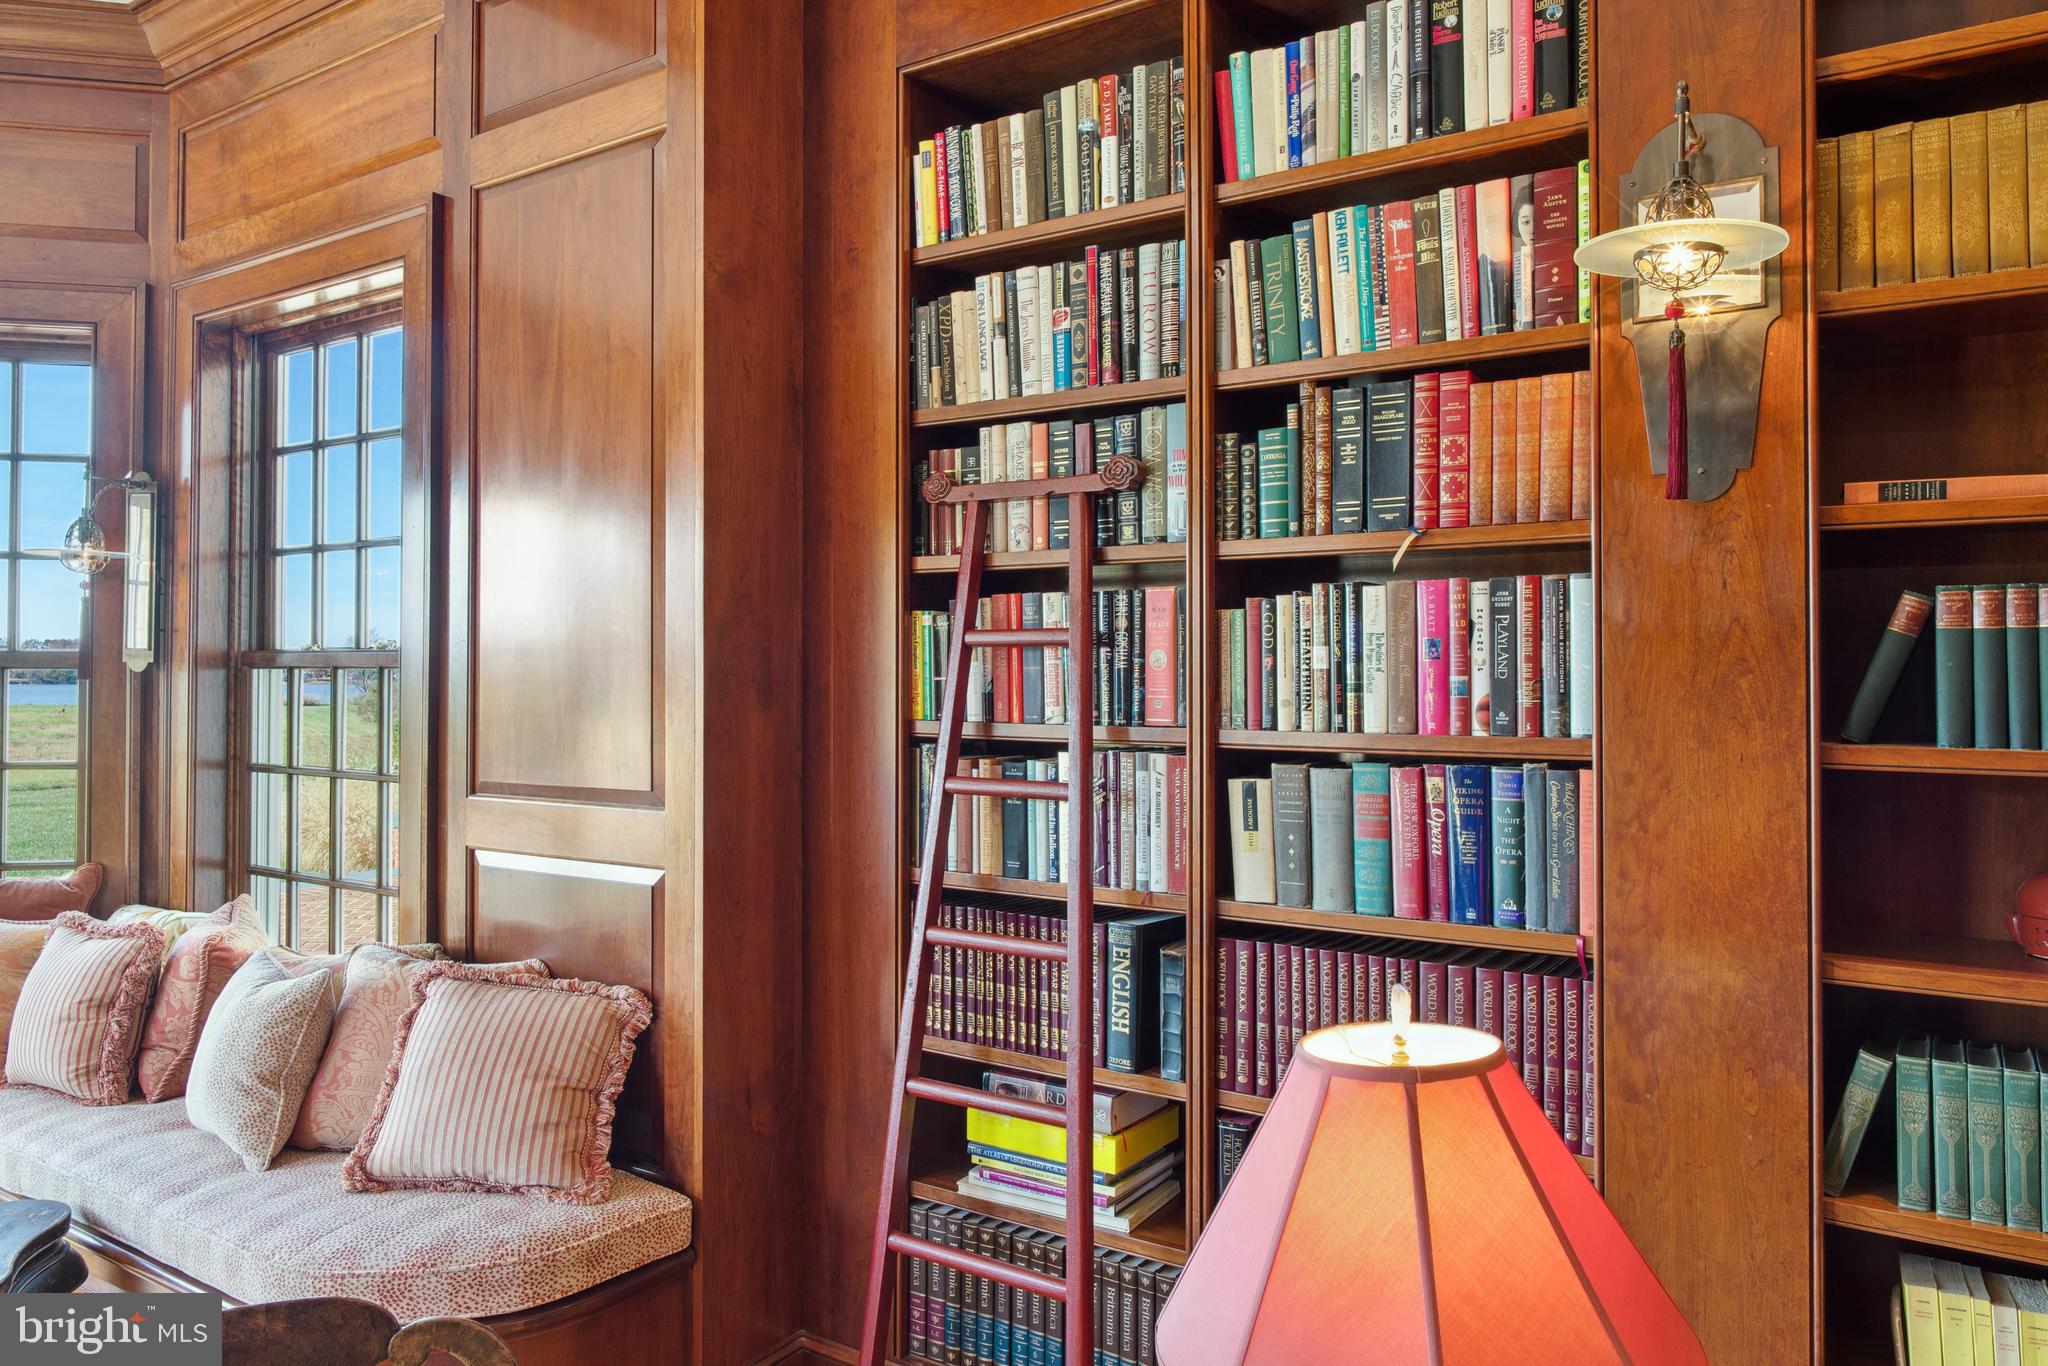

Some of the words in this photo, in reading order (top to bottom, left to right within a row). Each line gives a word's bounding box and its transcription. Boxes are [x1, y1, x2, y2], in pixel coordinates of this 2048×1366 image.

[1290, 59, 1299, 75] Our
[1518, 36, 1528, 99] ATONEMENT
[1103, 80, 1112, 89] P.
[1103, 91, 1112, 101] D.
[1149, 75, 1157, 95] GAY
[1157, 73, 1166, 93] THY
[1287, 75, 1299, 94] Gang
[1103, 103, 1112, 134] JAMES
[1149, 97, 1157, 134] TALESE
[1289, 95, 1300, 119] Philip
[1157, 95, 1166, 155] NEIGHBOR'S
[1288, 120, 1300, 137] Roth
[946, 129, 960, 174] MINDBEND
[1050, 124, 1058, 158] STRONG
[1081, 135, 1090, 165] COLD
[1051, 160, 1059, 201] MEDICINE
[1157, 157, 1166, 180] WIFE
[948, 175, 961, 199] ROBIN
[1546, 194, 1563, 202] JANE
[950, 199, 962, 221] COOK
[1542, 199, 1567, 208] AUSTEN
[1334, 210, 1348, 230] KEN
[1336, 233, 1350, 274] FOLLETT
[1416, 239, 1440, 251] Fools
[1100, 255, 1112, 278] JOHN
[1359, 240, 1368, 285] Housekeeper's
[1123, 277, 1134, 311] PRESUMED
[1296, 238, 1313, 321] MASTERSTROKE
[977, 293, 986, 314] ON
[1020, 299, 1033, 314] The
[1100, 278, 1112, 316] GRISHAM
[1265, 255, 1286, 335] TRINITY
[1360, 286, 1369, 306] Diary
[939, 303, 952, 337] XPD
[1142, 266, 1157, 356] TUROW
[1020, 316, 1034, 339] Jeeves
[1102, 319, 1110, 334] THE
[1123, 314, 1135, 345] INNOCENT
[978, 314, 988, 373] LANGUAGE
[1021, 340, 1035, 374] Omnibus
[1056, 334, 1064, 372] RHAPSODY
[1102, 335, 1111, 368] CHAMBER
[942, 357, 951, 392] Deighton
[1144, 422, 1162, 465] TOM
[1144, 471, 1163, 527] WOLFE
[1115, 593, 1129, 617] JOHN
[1134, 592, 1142, 606] THE
[1523, 584, 1533, 598] THE
[1134, 607, 1142, 629] STREET
[1427, 603, 1435, 632] BYATT
[1523, 601, 1533, 612] DA
[1262, 612, 1274, 649] GOD
[1523, 614, 1533, 635] VINCI
[1115, 631, 1129, 669] GRISHAM
[1495, 614, 1510, 679] PLAYLAND
[1523, 637, 1533, 656] CODE
[1101, 663, 1109, 679] JOHN
[1133, 658, 1141, 679] JOHN
[1301, 627, 1311, 712] HEARTBURN
[1523, 663, 1533, 677] DAN
[1101, 682, 1110, 712] GRISHAM
[1133, 680, 1141, 712] GRISHAM
[1523, 681, 1533, 708] BROWN
[1126, 759, 1134, 773] THE
[1126, 777, 1134, 797] MAN
[1410, 782, 1418, 799] THE
[1453, 797, 1484, 805] OPERA
[1127, 801, 1135, 825] FROM
[1403, 783, 1411, 839] ANNOTATED
[1410, 802, 1418, 823] NEW
[1454, 808, 1484, 816] GUIDE
[1496, 816, 1521, 825] NIGHT
[1563, 782, 1575, 855] BALANCHINE'S
[1411, 825, 1419, 860] OXFORD
[1427, 808, 1446, 857] Opera
[1404, 842, 1412, 868] BIBLE
[1495, 847, 1523, 856] OPERA
[1278, 954, 1287, 988] WORLD
[1293, 956, 1301, 991] WORLD
[1308, 958, 1316, 994] WORLD
[1323, 960, 1331, 996] WORLD
[1111, 945, 1131, 1034] ENGLISH
[1278, 990, 1287, 1017] BOOK
[1508, 983, 1518, 1021] WORLD
[1527, 985, 1537, 1023] WORLD
[1293, 992, 1301, 1020] BOOK
[1308, 995, 1316, 1022] BOOK
[1323, 998, 1331, 1025] BOOK
[1548, 988, 1557, 1026] WORLD
[1568, 990, 1577, 1028] WORLD
[1508, 1023, 1518, 1052] BOOK
[1527, 1025, 1537, 1055] BOOK
[1548, 1028, 1557, 1058] BOOK
[1568, 1031, 1577, 1061] BOOK
[1223, 1133, 1231, 1149] THE
[970, 1146, 983, 1156] THE
[983, 1149, 1001, 1159] ATLAS
[1000, 1152, 1009, 1160] OF
[1009, 1154, 1045, 1170] LEGENDARY
[1223, 1153, 1231, 1176] ILIAD
[1106, 1286, 1116, 1346] Britannica
[1123, 1292, 1133, 1352] Britannica
[1141, 1297, 1151, 1357] Britannica
